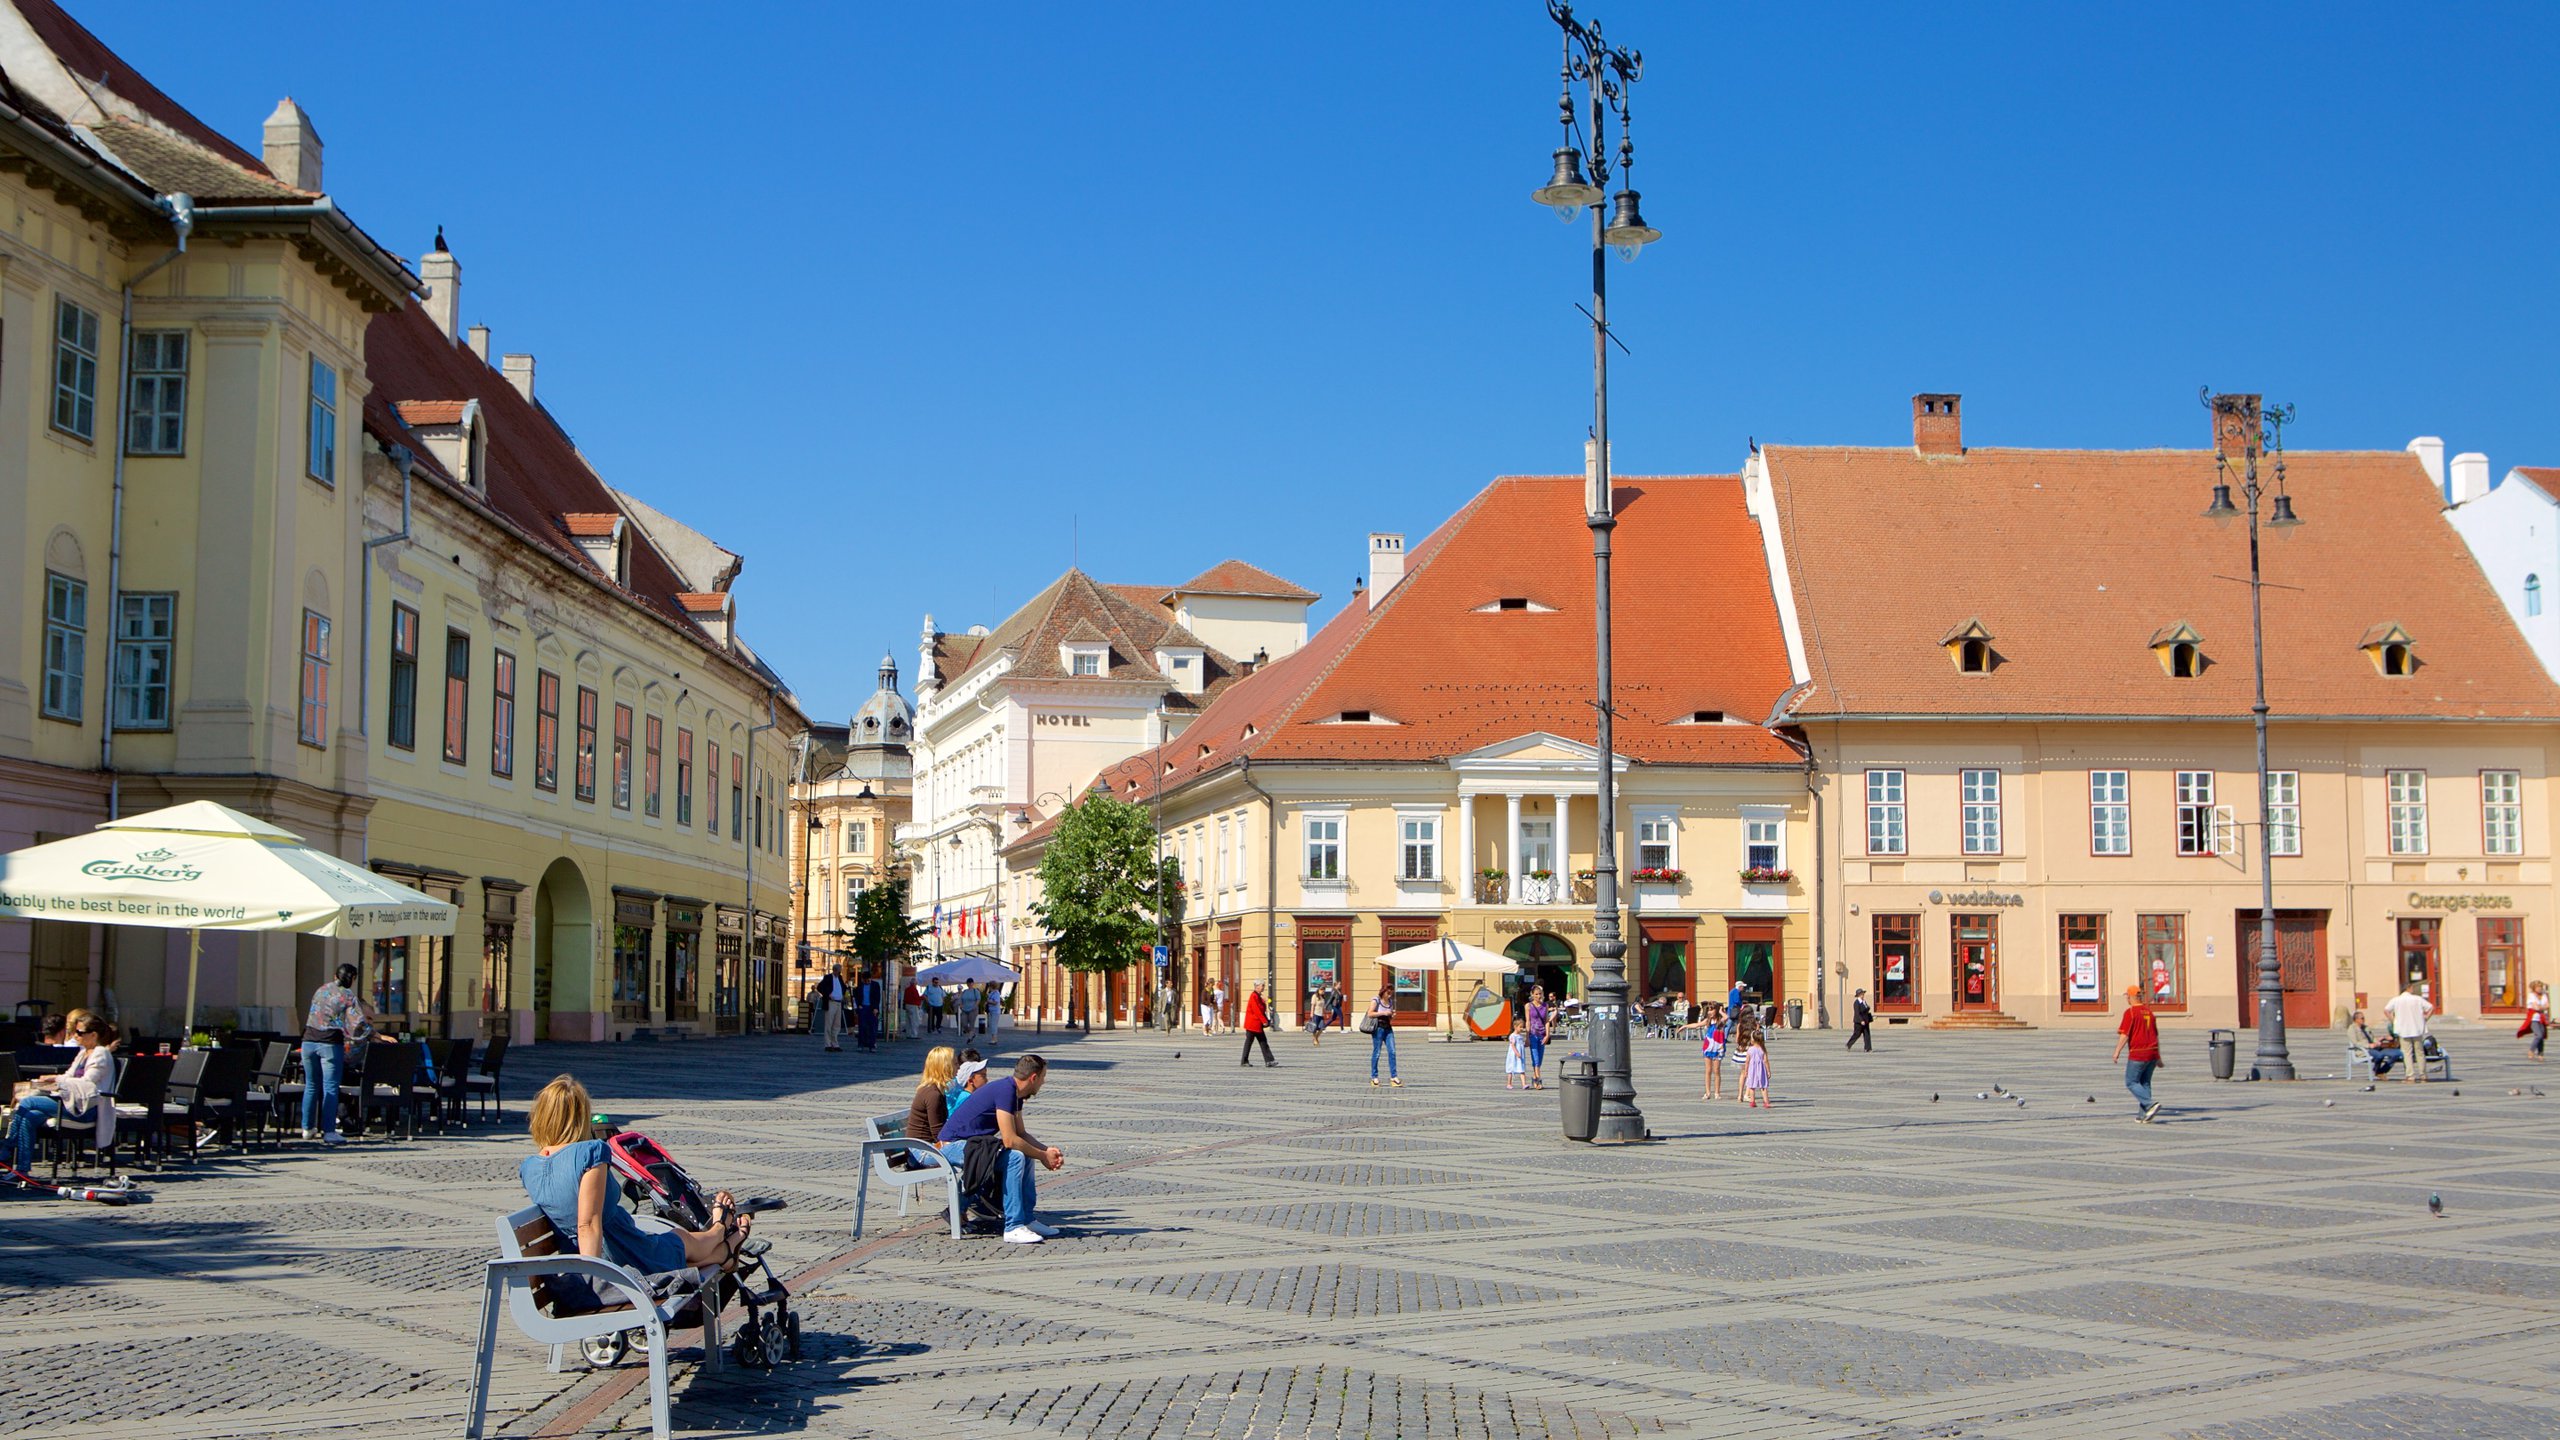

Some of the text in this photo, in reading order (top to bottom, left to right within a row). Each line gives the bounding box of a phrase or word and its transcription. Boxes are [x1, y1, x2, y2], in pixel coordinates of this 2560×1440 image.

[1036, 713, 1091, 727] HOTEL
[81, 859, 204, 883] Carlsberg
[1946, 890, 2024, 907] vodafone
[2408, 891, 2513, 912] Orange store
[51, 896, 75, 910] the
[81, 896, 112, 912] best
[118, 898, 151, 914] beer
[157, 902, 170, 916] in
[175, 903, 198, 917] the
[203, 906, 245, 919] world
[419, 909, 429, 921] the
[430, 909, 448, 922] world
[1301, 927, 1346, 938] Bancpost
[1387, 927, 1431, 938] Bancpost
